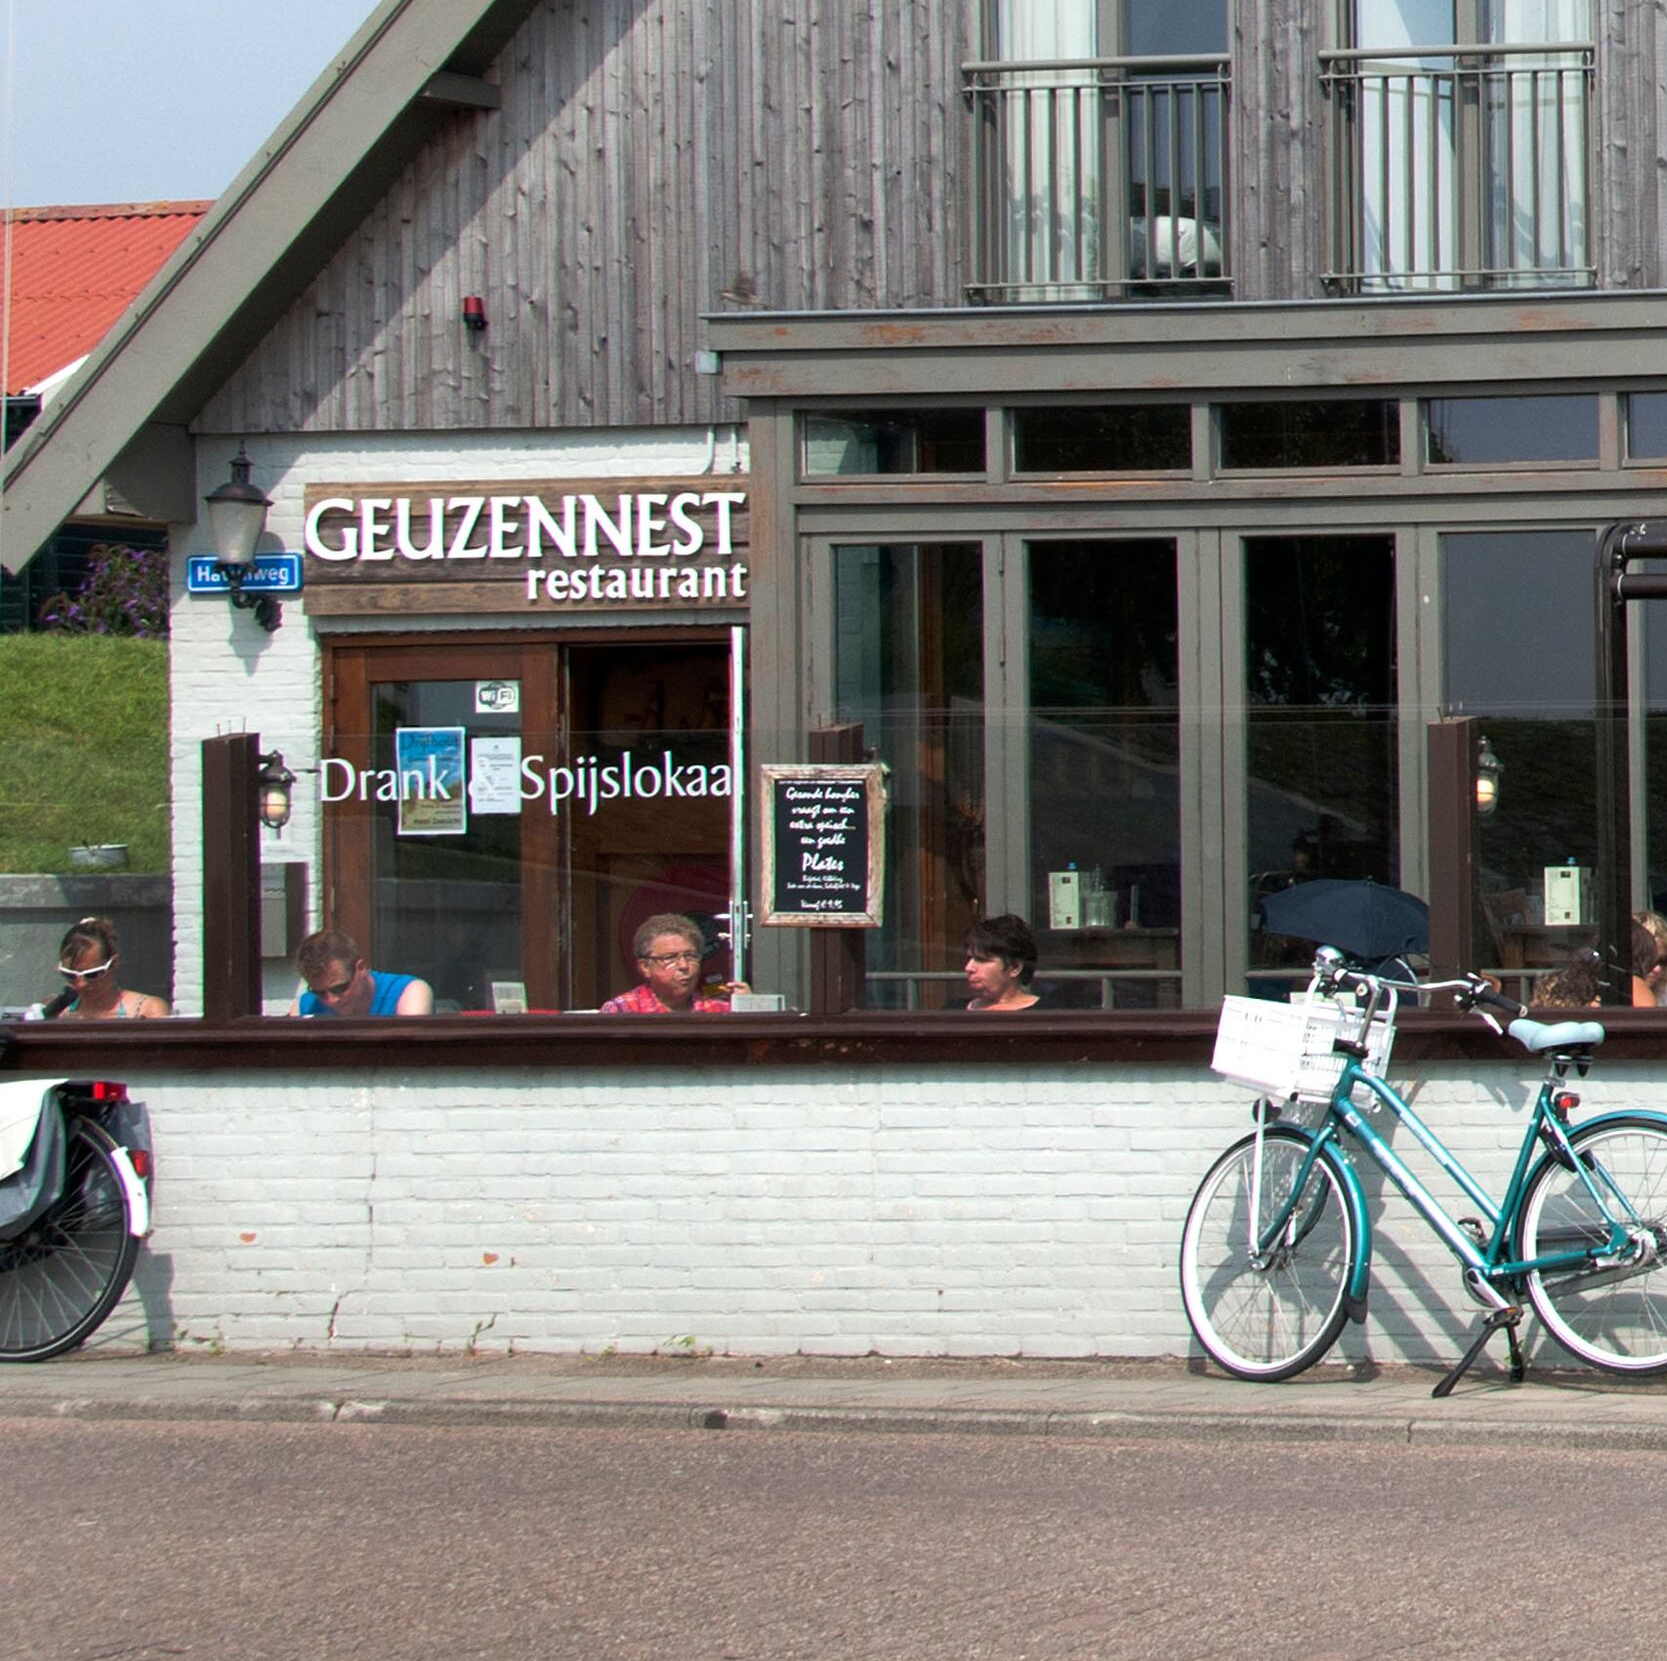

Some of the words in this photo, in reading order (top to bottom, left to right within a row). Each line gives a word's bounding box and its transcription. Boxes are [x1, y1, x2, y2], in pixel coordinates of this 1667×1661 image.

[304, 491, 747, 562] GEUZENNEST
[197, 565, 290, 585] Havnweg
[527, 562, 748, 601] restaurant
[320, 755, 452, 802] Drank
[521, 750, 744, 816] Spijslokaa
[802, 852, 844, 872] Plates
